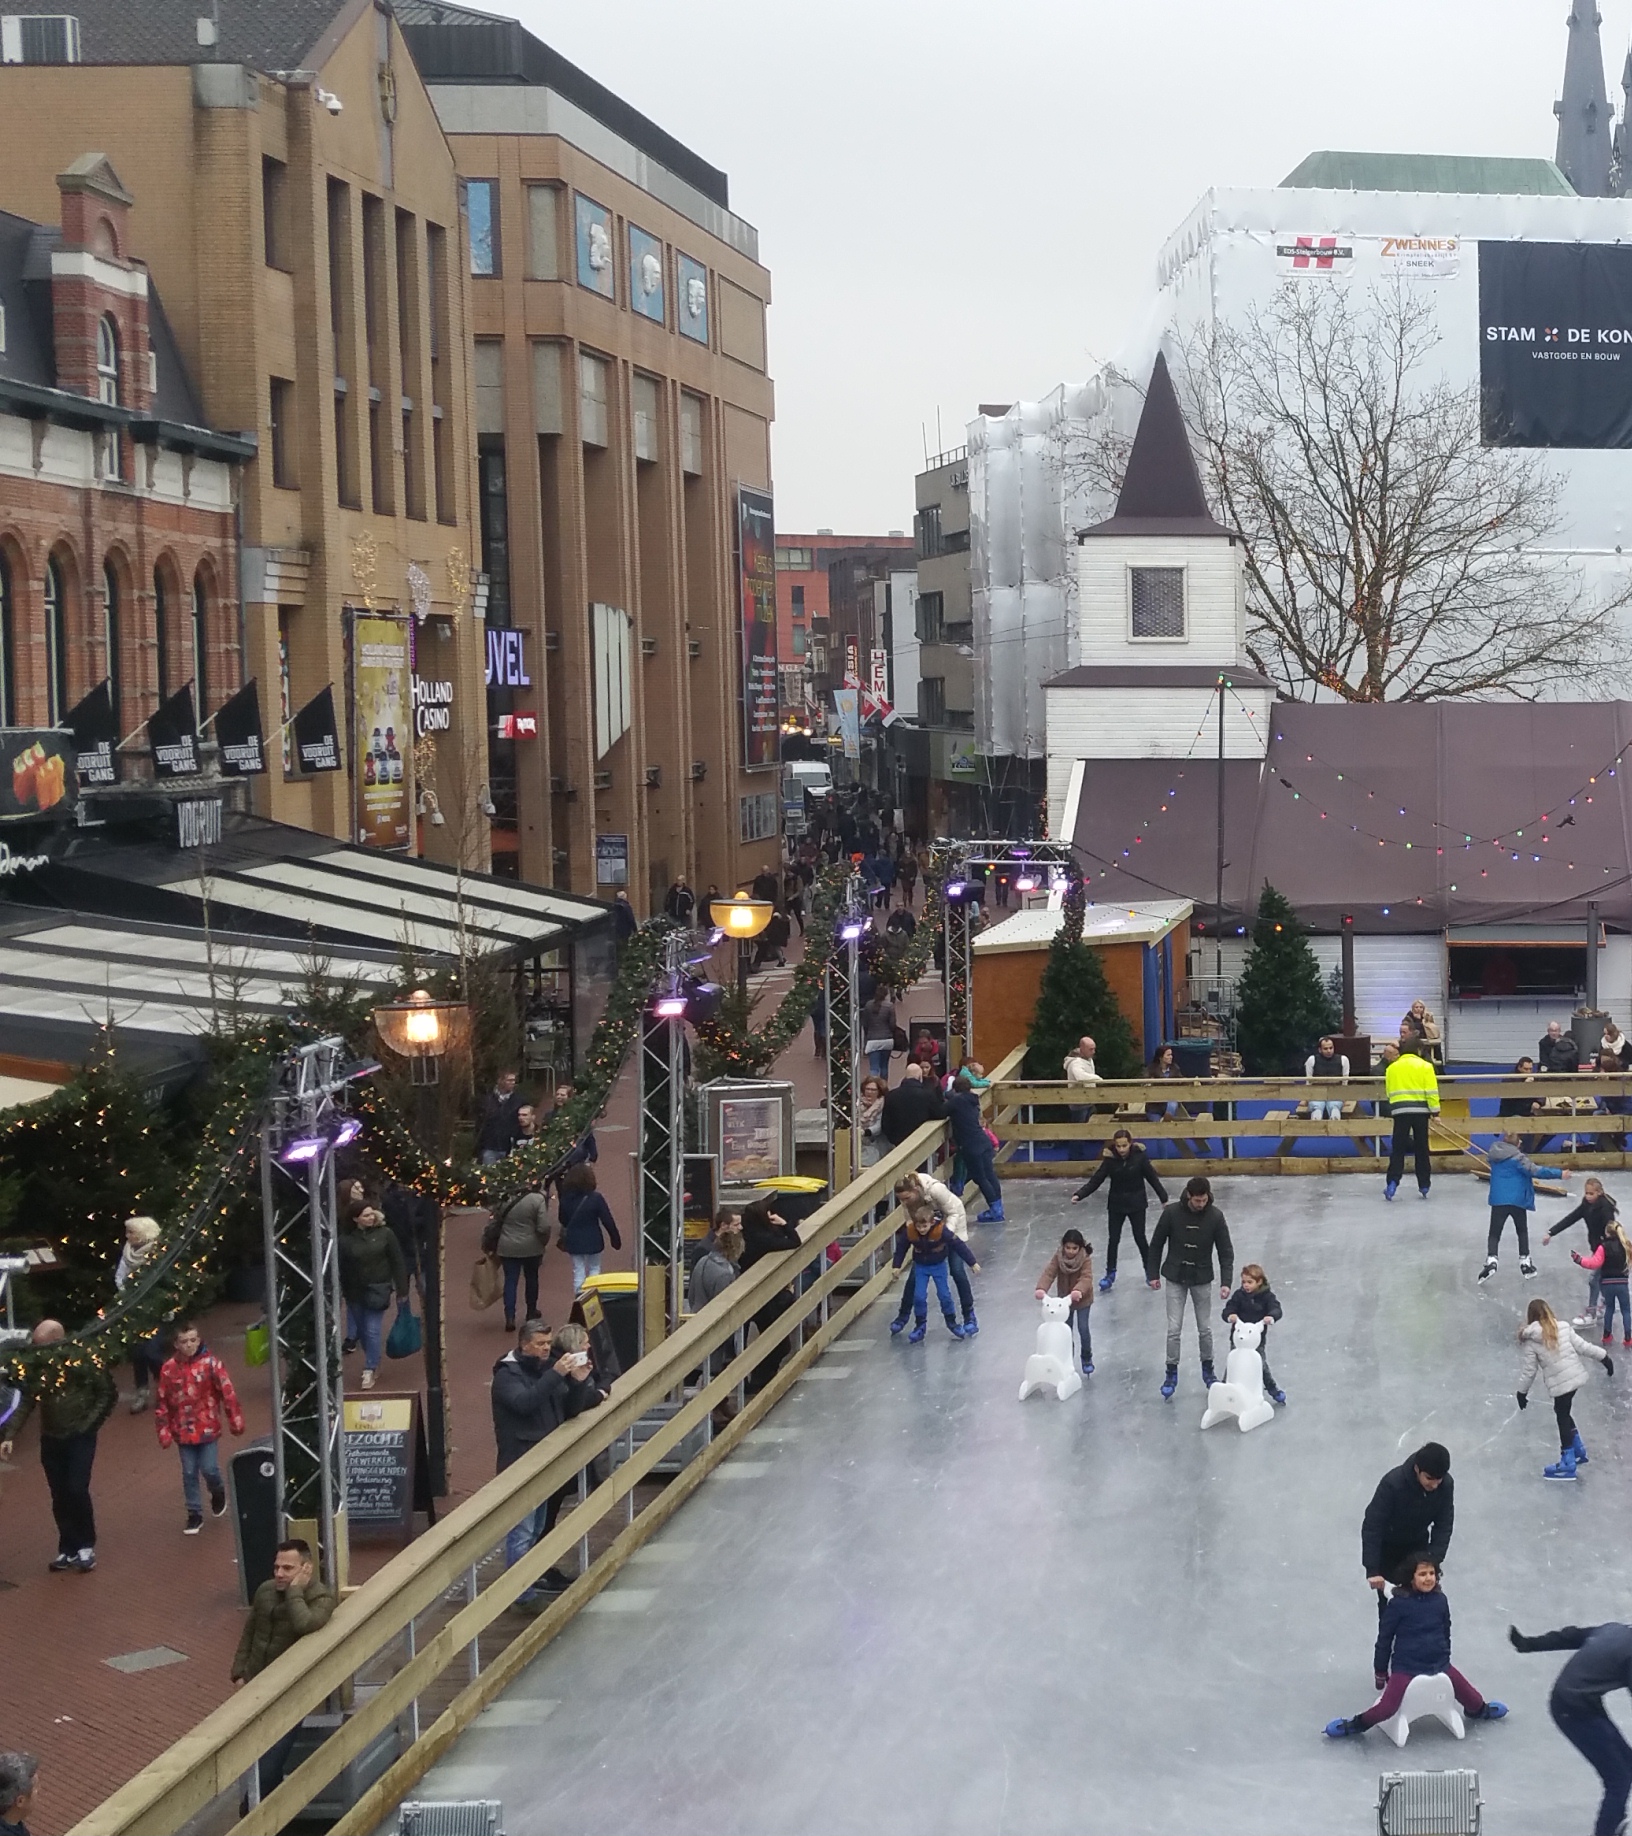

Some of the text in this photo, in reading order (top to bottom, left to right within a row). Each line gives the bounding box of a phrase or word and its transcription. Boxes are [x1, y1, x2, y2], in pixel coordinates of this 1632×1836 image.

[1380, 237, 1457, 257] ZWENNES
[1405, 260, 1435, 268] SNEEK
[1486, 326, 1536, 342] STAM
[1567, 328, 1591, 343] DE
[1531, 351, 1621, 361] VASTGOED EN BOUW
[410, 673, 453, 710] HOLLAND
[417, 705, 450, 738] CASINO
[181, 735, 193, 747] DE
[247, 735, 259, 747] DE
[323, 734, 334, 746] DE
[98, 742, 111, 755] DE
[155, 746, 194, 761] VOORUIT
[223, 746, 259, 760] VOORUIT
[302, 745, 335, 758] VOORUIT
[77, 754, 112, 769] OORUIT
[171, 758, 198, 773] GANG
[238, 758, 263, 771] GANG
[315, 756, 337, 769] GANG
[88, 767, 115, 782] GANG
